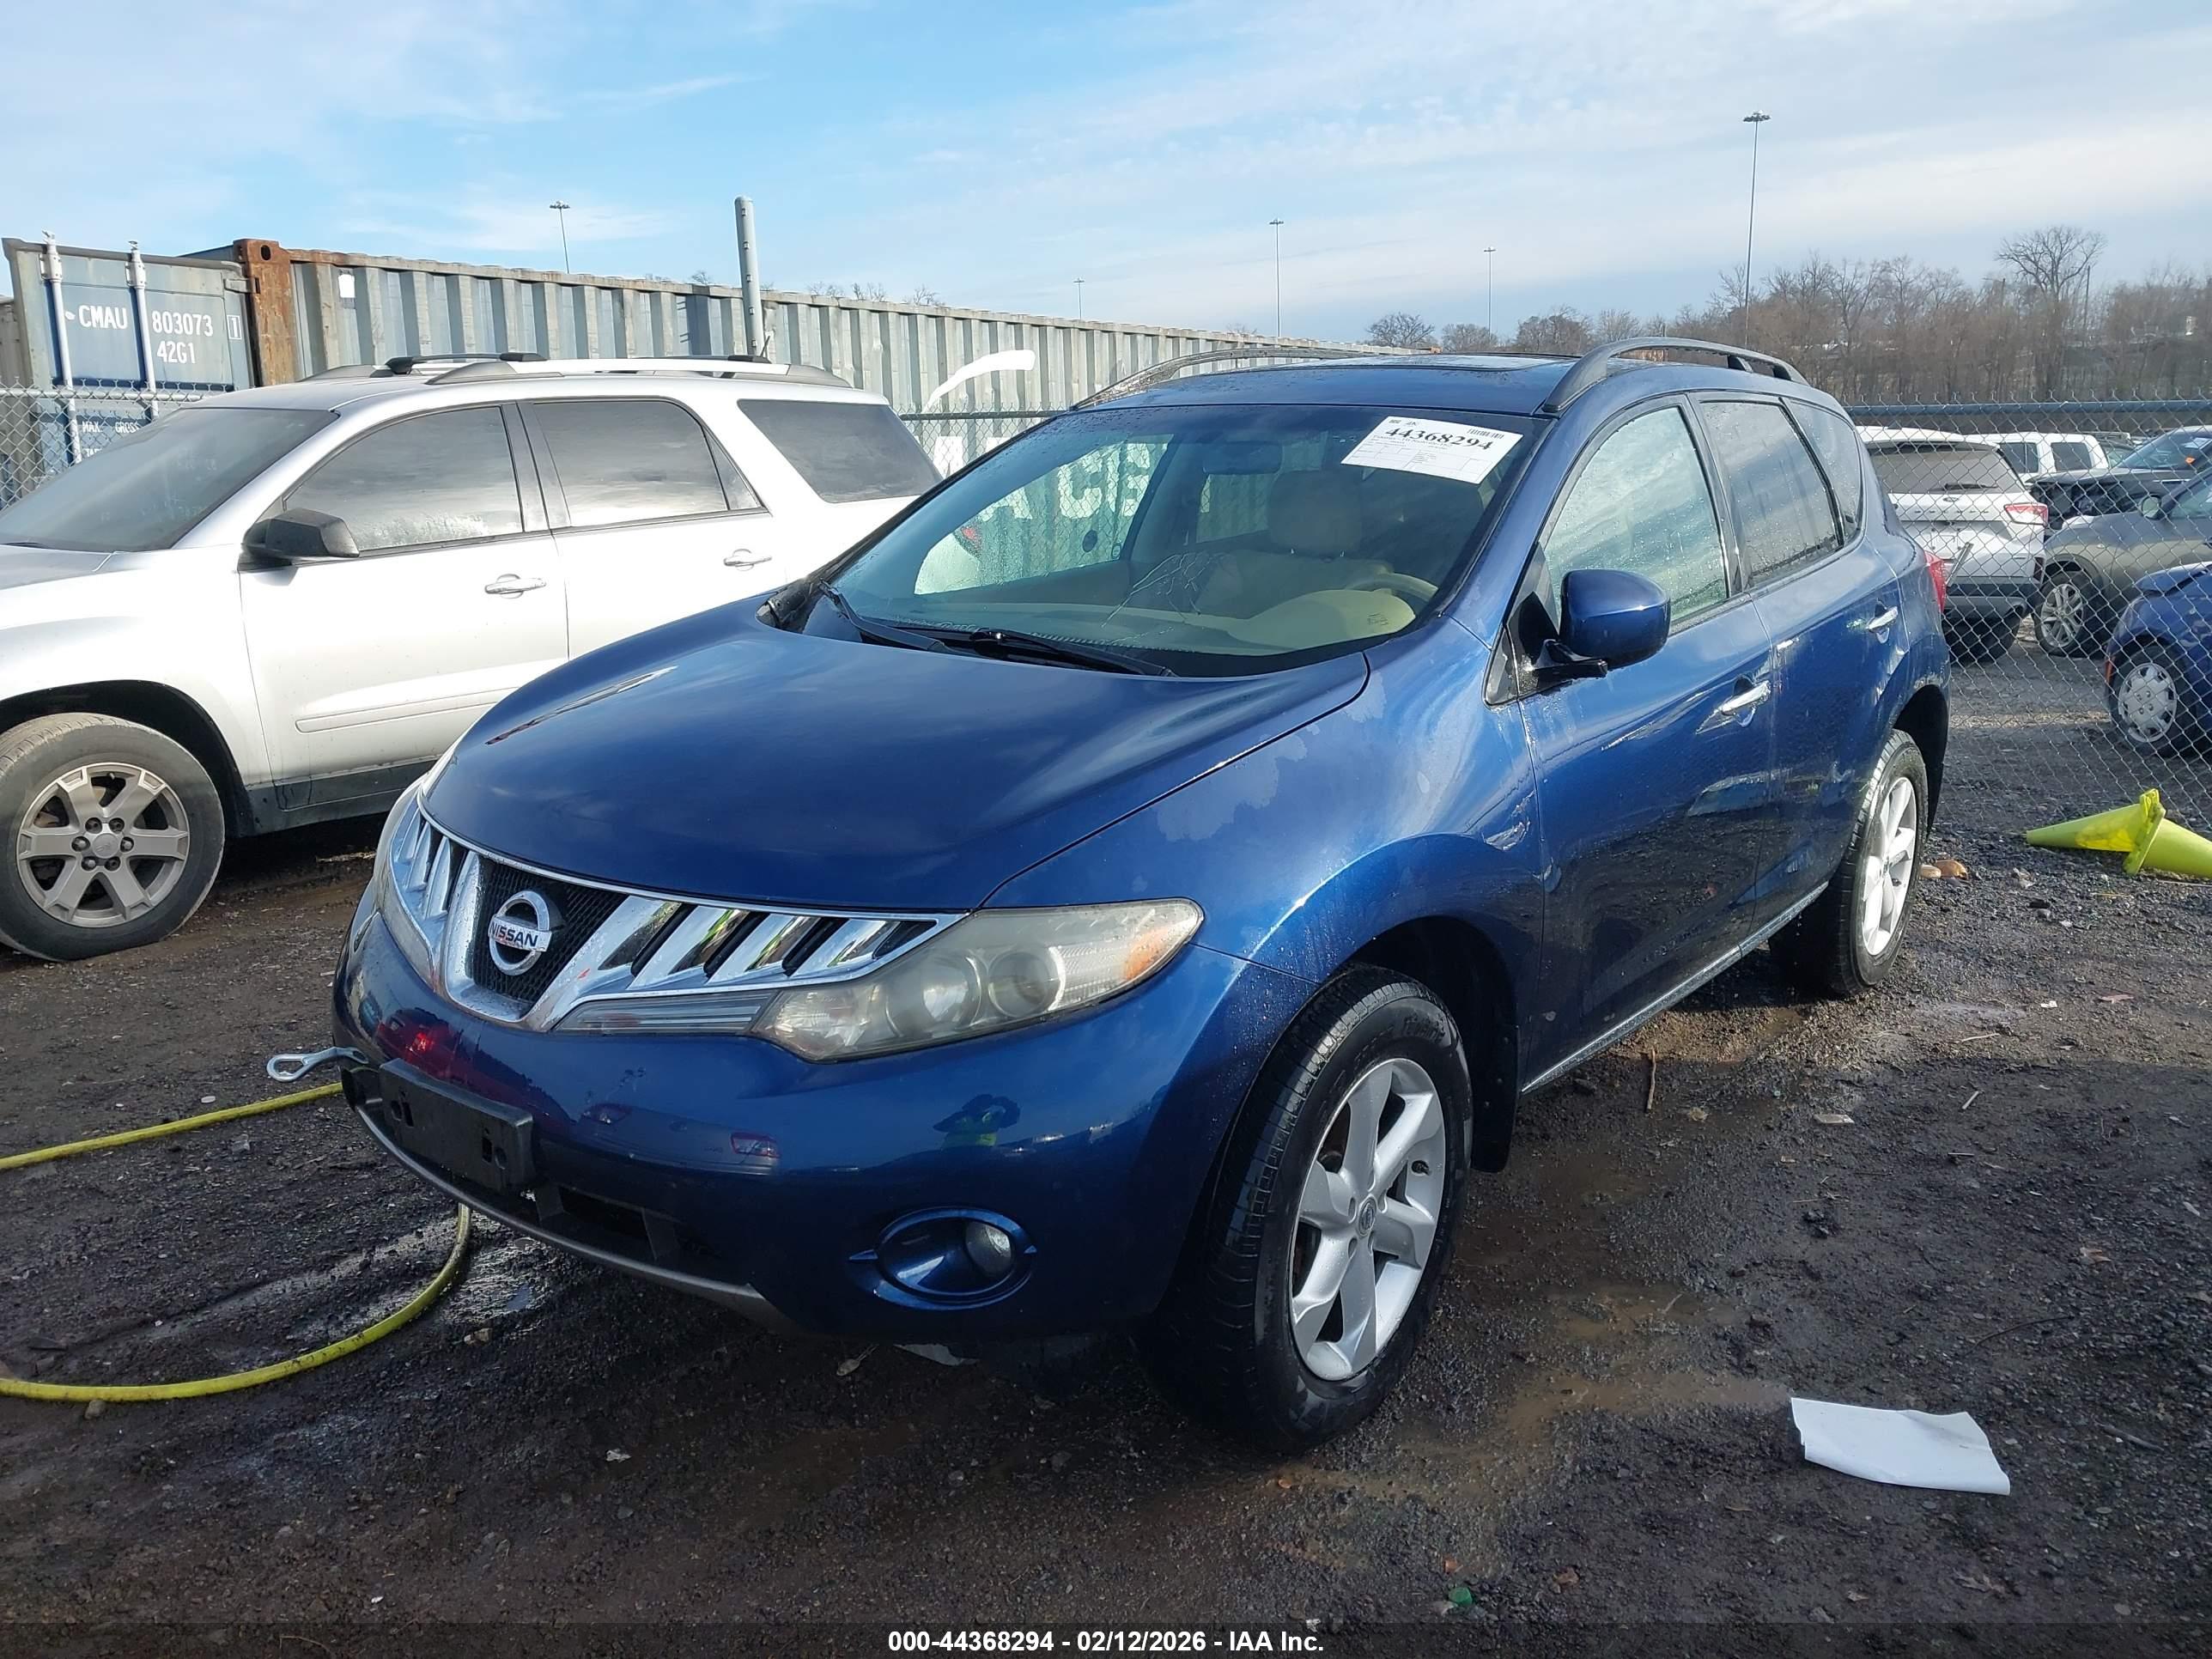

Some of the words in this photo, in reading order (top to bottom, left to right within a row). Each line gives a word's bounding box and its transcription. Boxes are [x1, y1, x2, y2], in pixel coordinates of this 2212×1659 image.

[78, 305, 128, 330] CMAU
[151, 310, 214, 337] 803073
[156, 341, 196, 364] 42G1
[1385, 428, 1494, 451] 44368294
[489, 921, 538, 947] NISSAN
